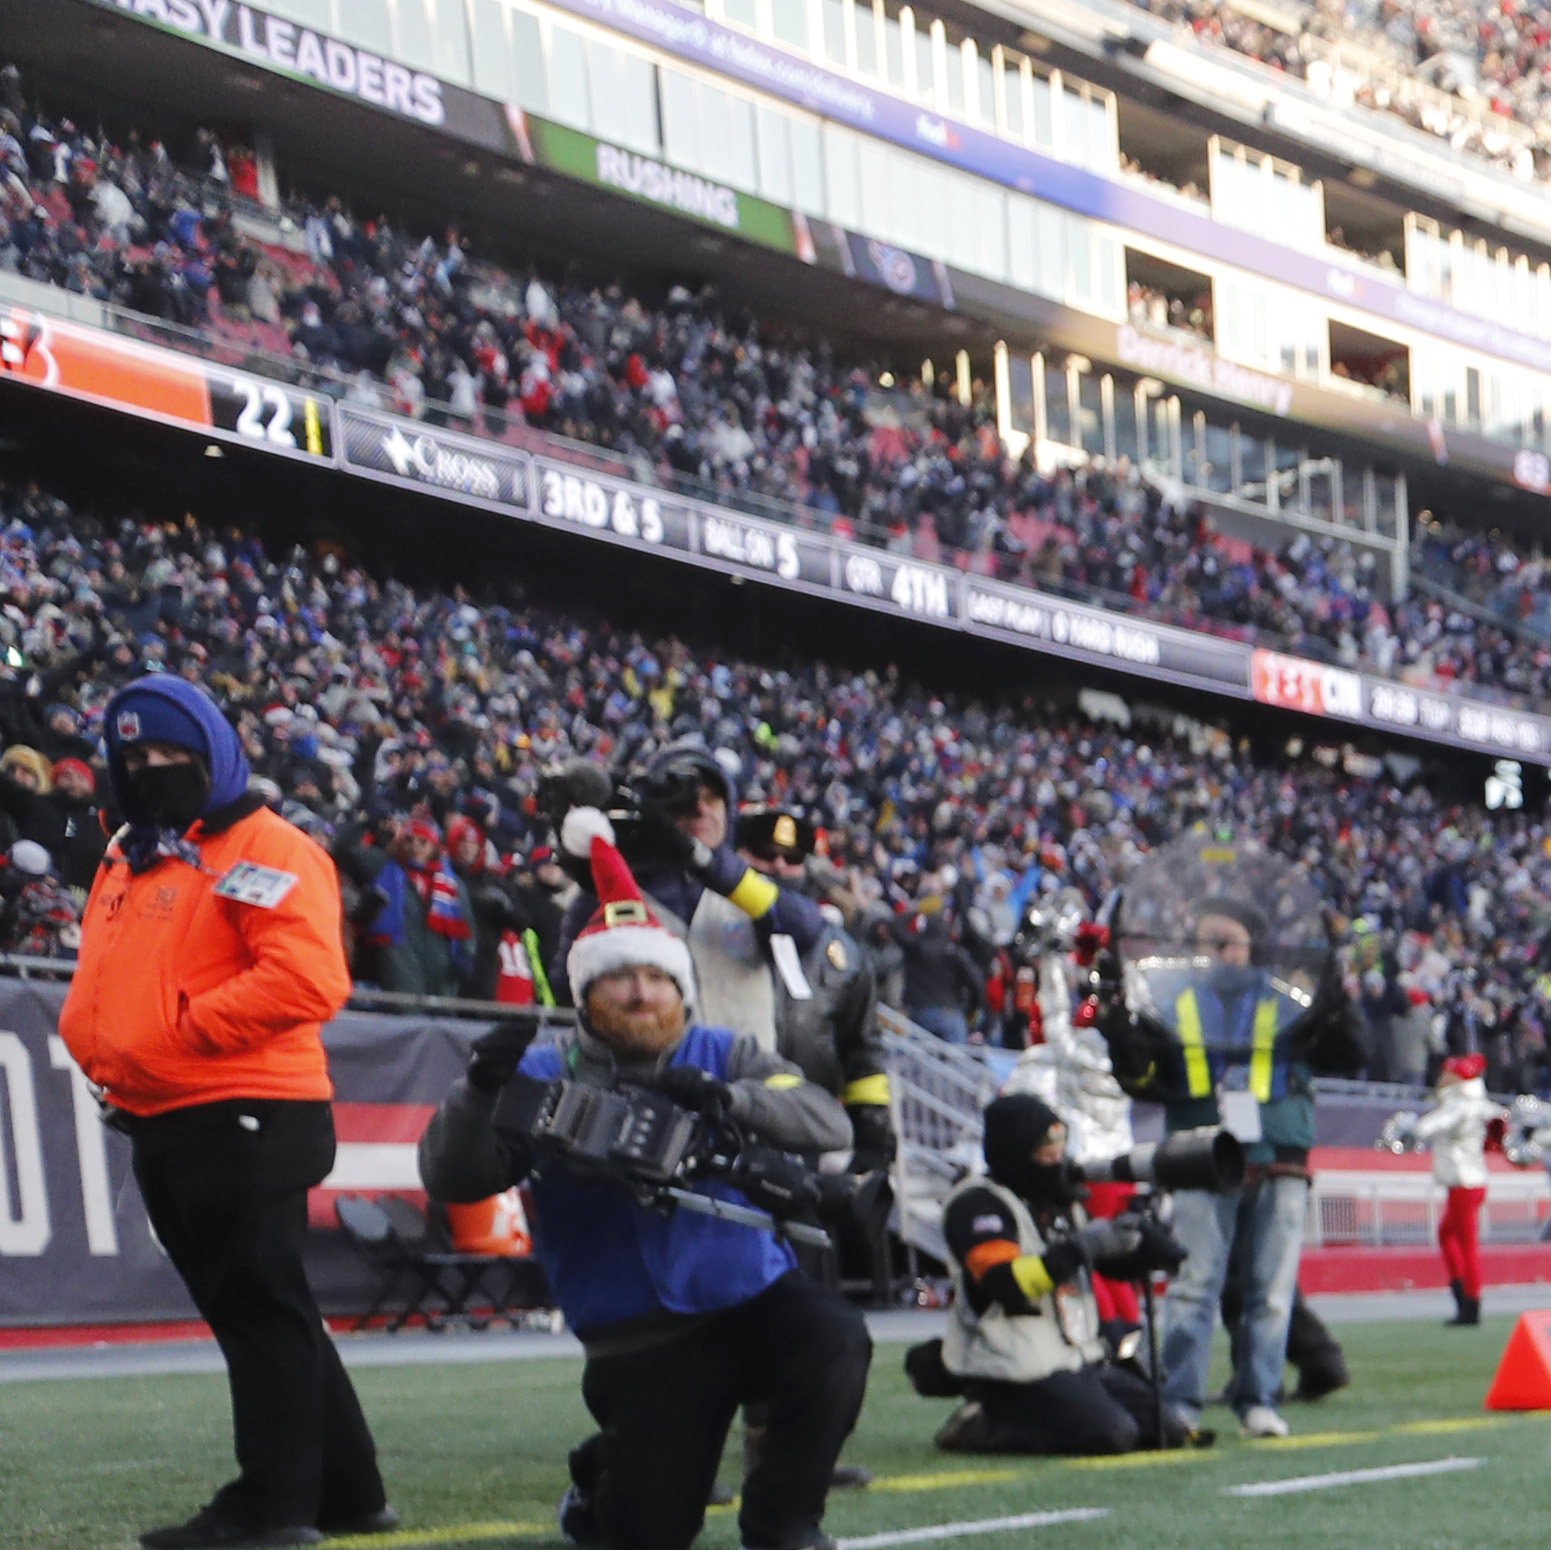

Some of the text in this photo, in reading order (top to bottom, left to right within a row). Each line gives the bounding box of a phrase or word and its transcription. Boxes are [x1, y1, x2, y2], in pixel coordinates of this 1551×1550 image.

[236, 6, 446, 125] LEADERS
[595, 141, 740, 227] RUSHING
[234, 379, 298, 450] 22
[542, 468, 665, 545] 3RD & 5
[775, 530, 799, 581] 5
[890, 562, 951, 620] 4TH
